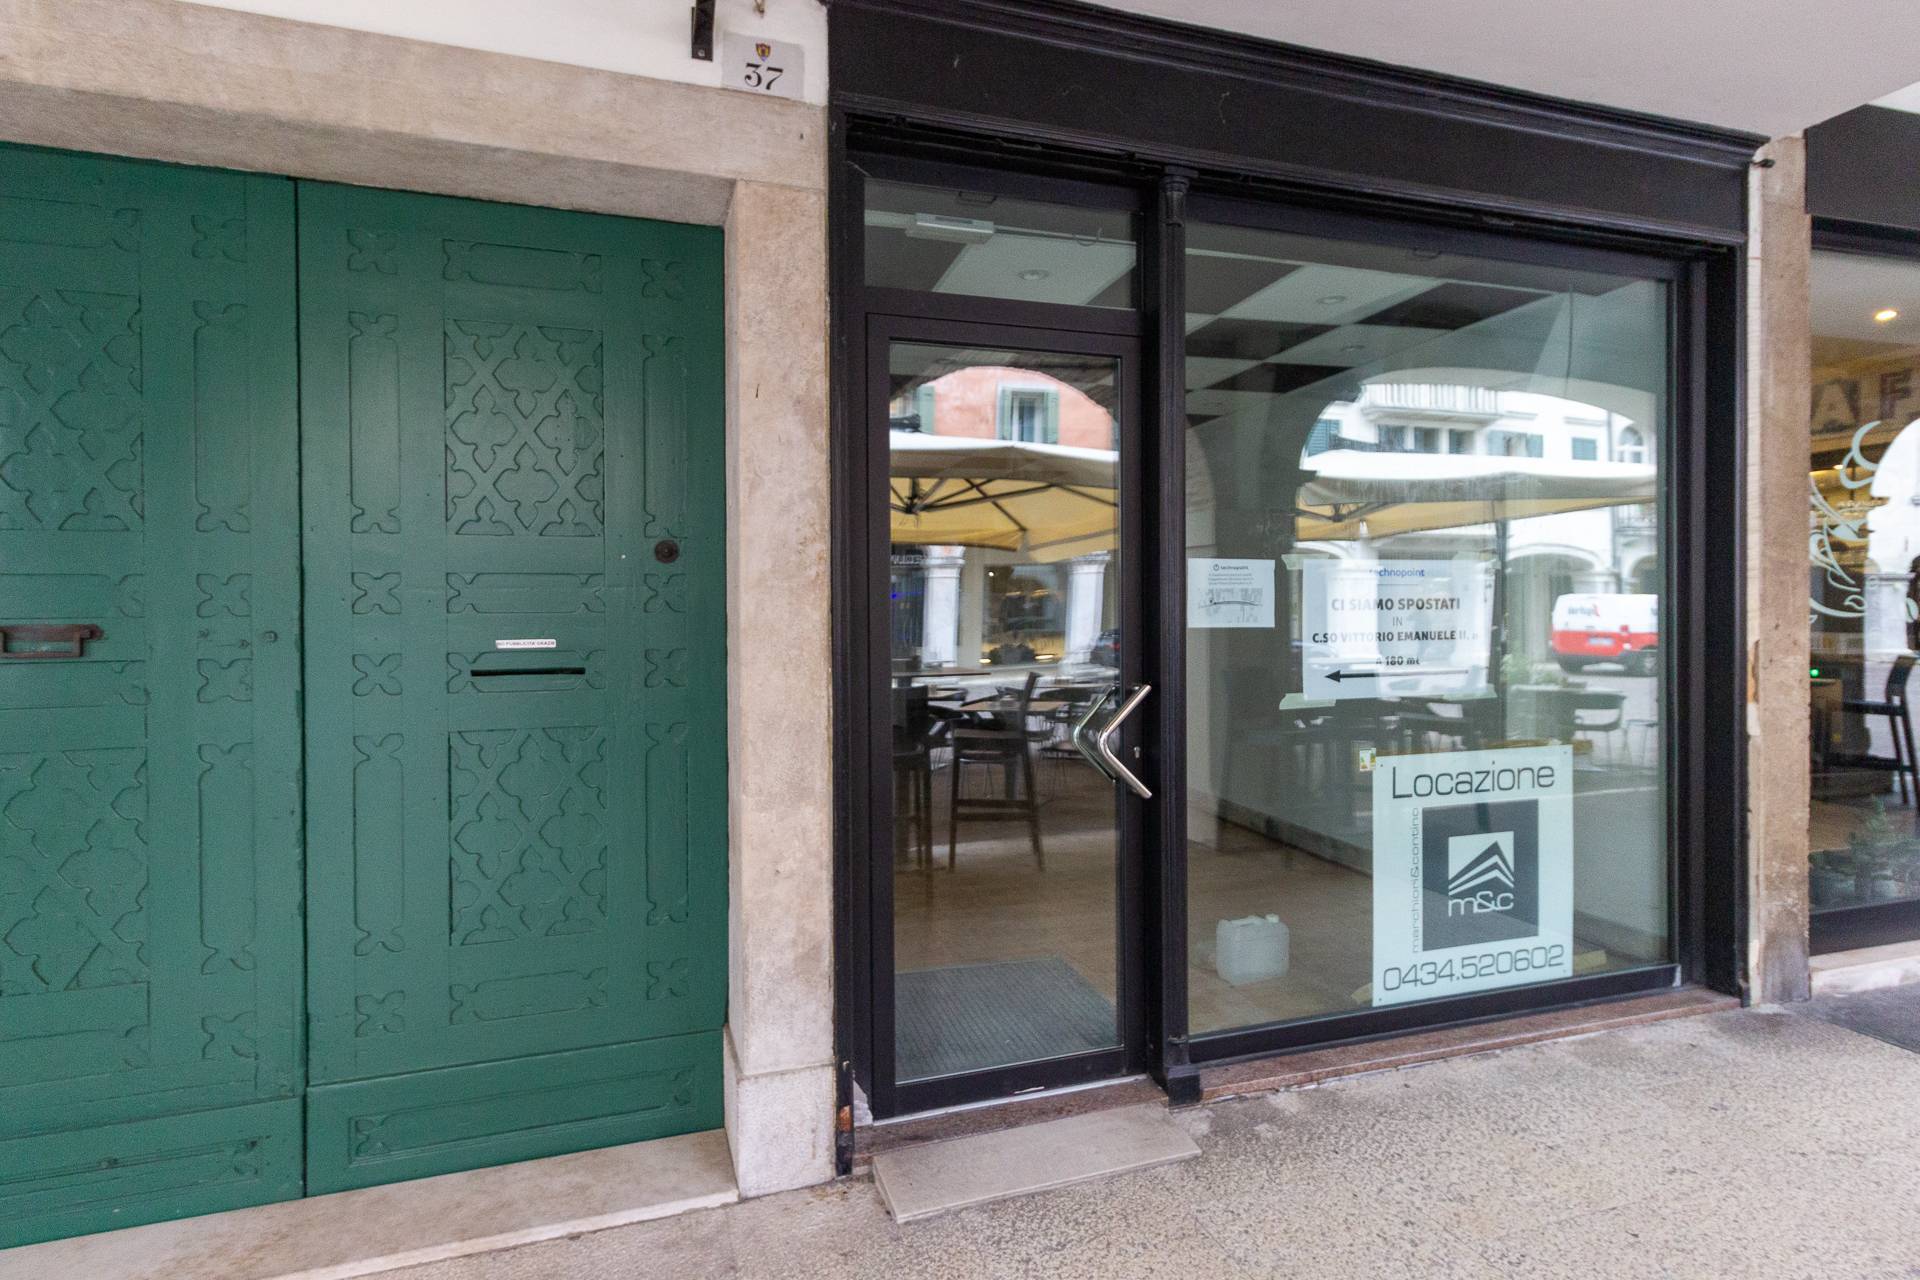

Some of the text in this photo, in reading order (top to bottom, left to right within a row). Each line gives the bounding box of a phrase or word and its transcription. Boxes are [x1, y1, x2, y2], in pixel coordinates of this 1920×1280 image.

[744, 62, 784, 90] 37
[1369, 568, 1425, 578] echnopoint
[1331, 598, 1461, 611] CI SIAMO SPOSTATI
[1393, 616, 1403, 626] IN
[1312, 631, 1338, 644] C.SO
[1340, 631, 1394, 643] VITTORIO
[1397, 630, 1456, 641] EMANUELE
[1385, 655, 1404, 666] 180
[1392, 765, 1555, 799] Locazione
[1448, 890, 1515, 917] m&c
[1383, 944, 1565, 991] 0434.520602
